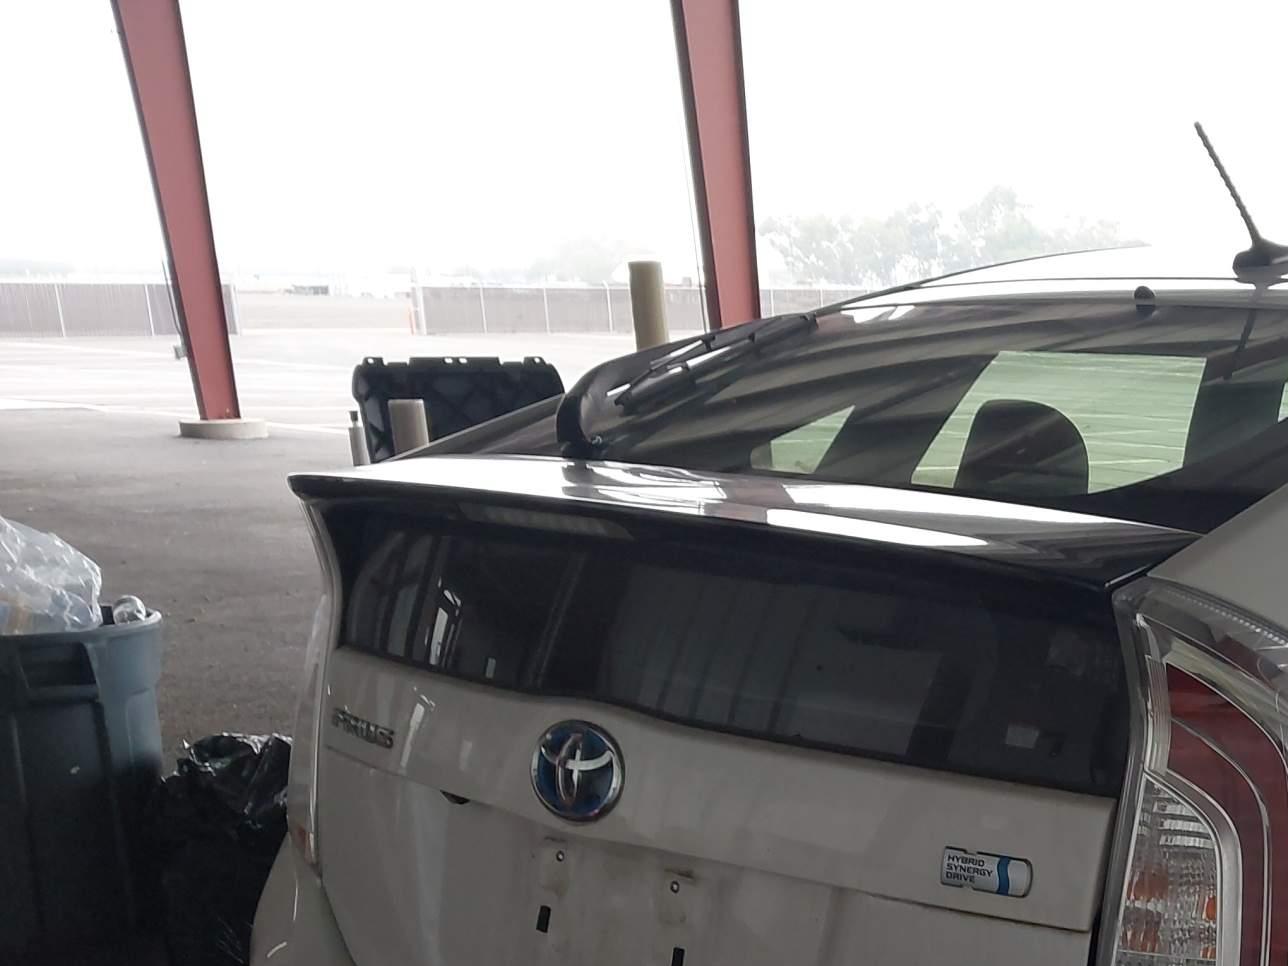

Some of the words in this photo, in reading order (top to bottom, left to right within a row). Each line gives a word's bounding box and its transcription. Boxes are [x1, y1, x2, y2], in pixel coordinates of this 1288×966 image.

[332, 708, 394, 749] PRIUS
[947, 854, 985, 867] HYBRID
[946, 863, 993, 877] SYNERGY
[945, 871, 975, 883] DRIVE
